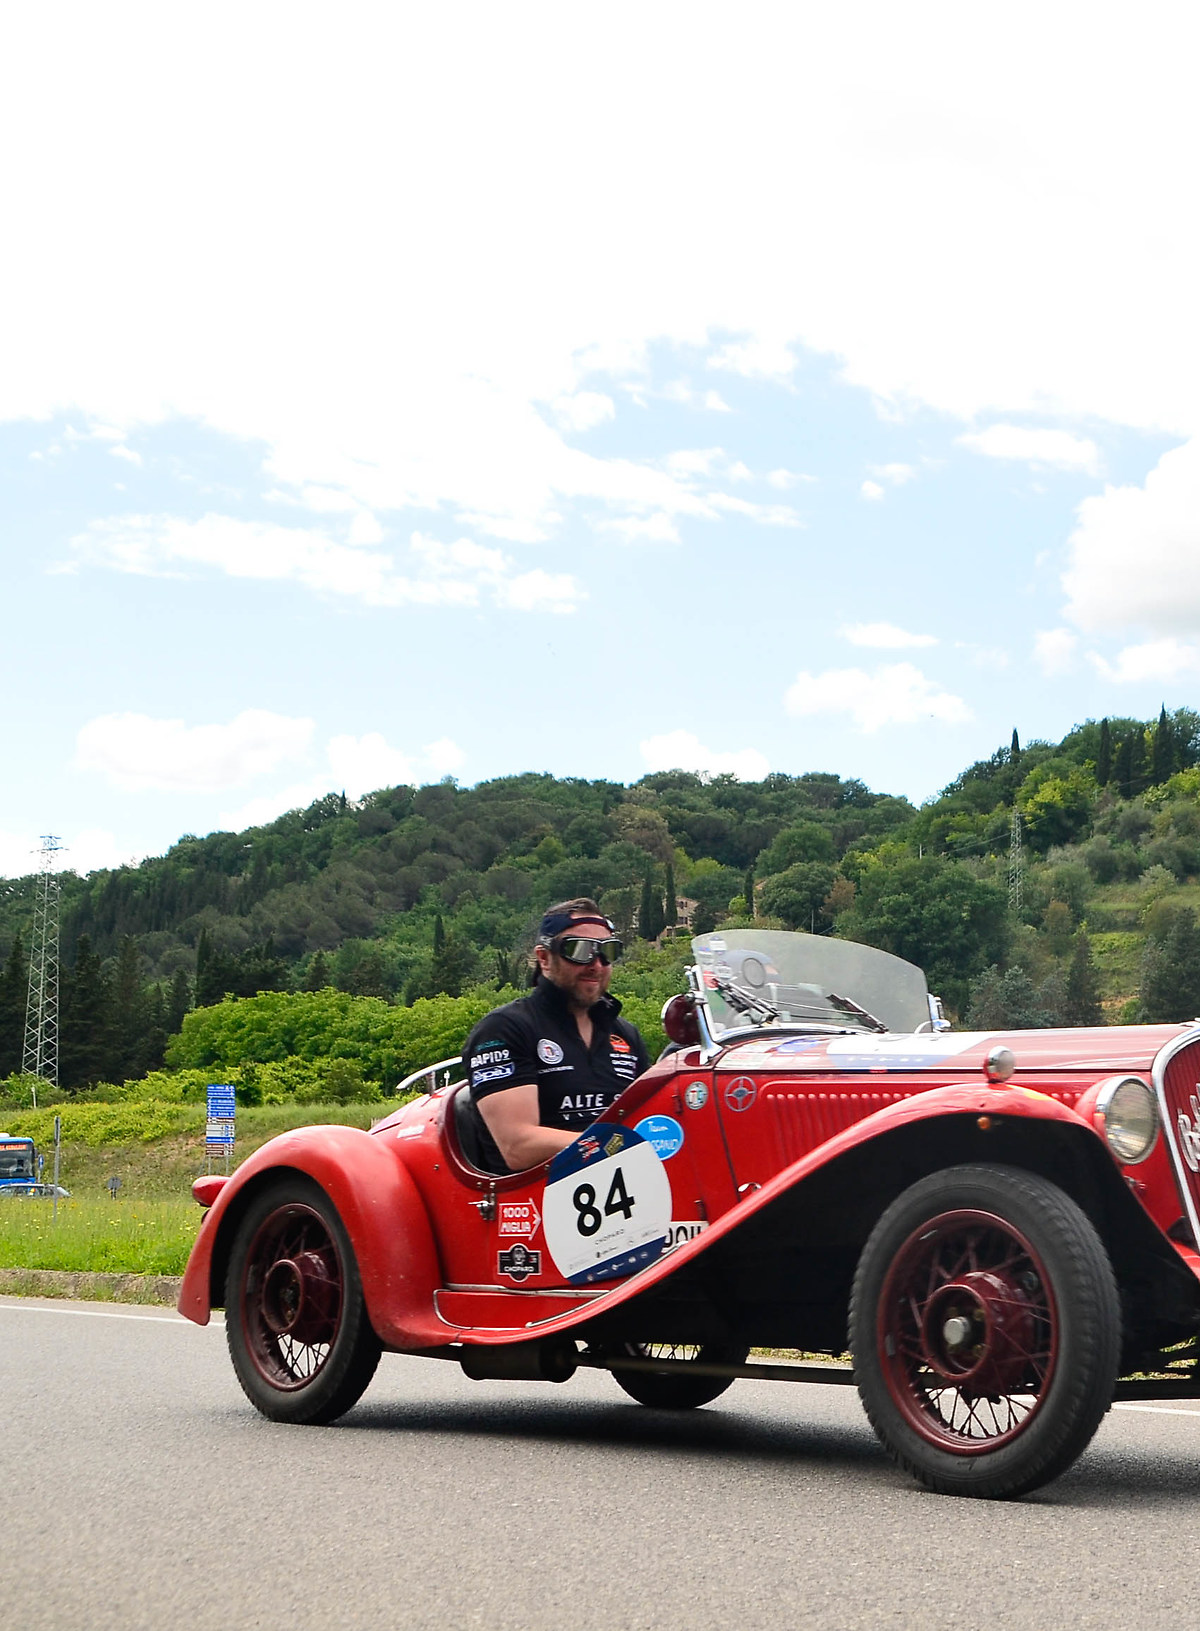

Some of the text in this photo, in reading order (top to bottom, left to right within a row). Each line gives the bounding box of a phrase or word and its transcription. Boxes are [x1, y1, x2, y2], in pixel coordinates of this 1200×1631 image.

[560, 1094, 604, 1109] ALTE
[573, 1167, 635, 1236] 84
[503, 1207, 529, 1218] 1000
[501, 1222, 531, 1232] MIGLIA
